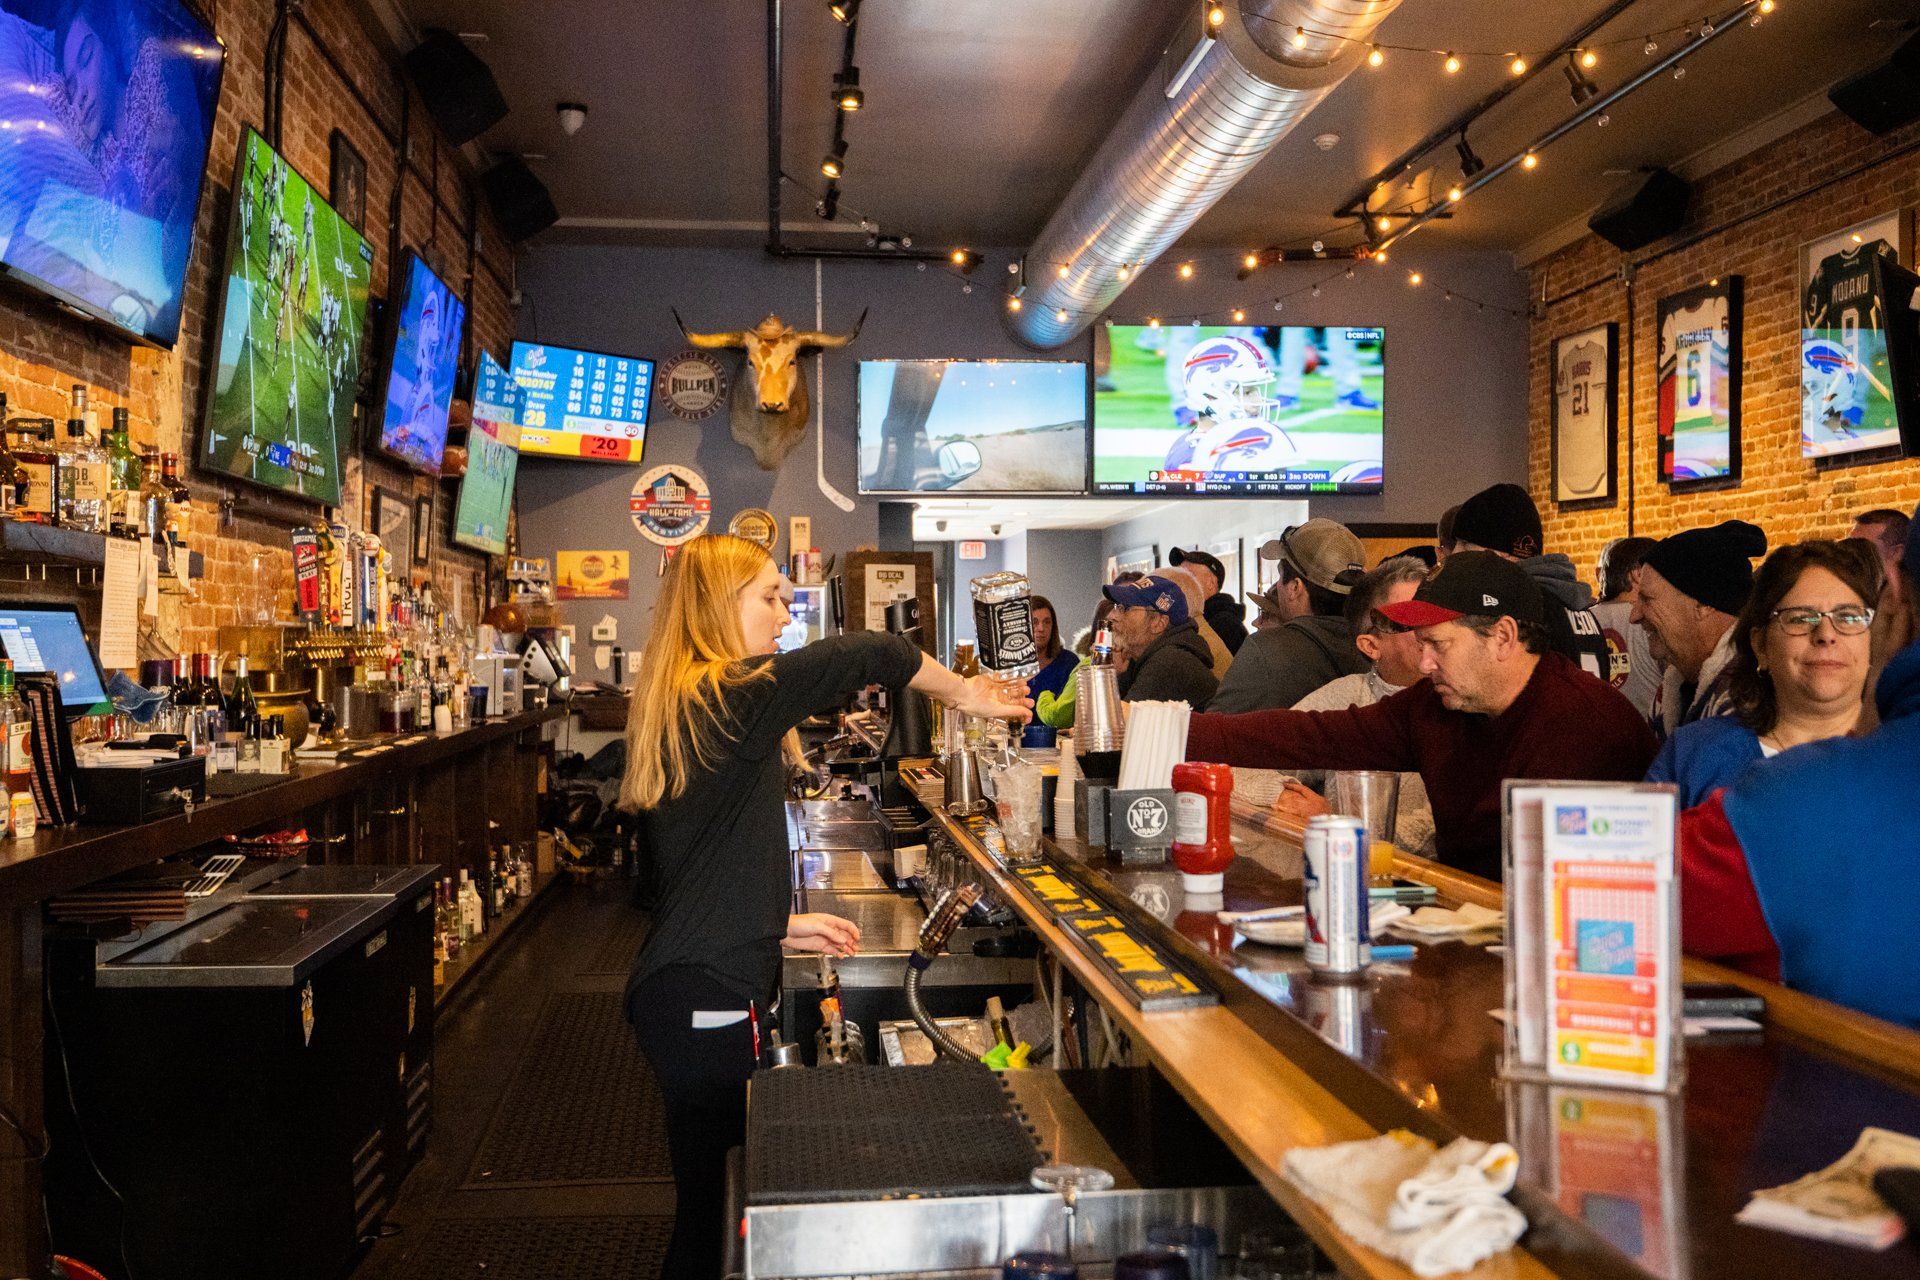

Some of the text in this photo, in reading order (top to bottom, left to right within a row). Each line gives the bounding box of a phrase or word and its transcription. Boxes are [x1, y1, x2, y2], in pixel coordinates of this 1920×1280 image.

[1831, 273, 1869, 304] MODANO
[597, 357, 606, 368] 11
[617, 360, 628, 371] 12
[514, 367, 558, 380] Draw Number
[1686, 349, 1702, 407] 6
[592, 381, 605, 392] 40
[672, 377, 715, 395] BULLPEN
[527, 401, 545, 409] Draw
[1572, 381, 1590, 416] 21
[589, 405, 602, 416] 70
[525, 410, 546, 426] 28
[74, 467, 88, 480] OB
[1303, 472, 1327, 480] DOWN
[649, 508, 669, 517] HALL
[673, 508, 693, 517] FAME
[648, 520, 696, 536] FESTIVAL
[964, 543, 982, 557] EXIT
[343, 577, 352, 617] TRULY
[1022, 642, 1037, 656] JACK
[1611, 654, 1628, 664] N'S
[1138, 800, 1155, 808] OLD
[1137, 826, 1161, 836] BRAND
